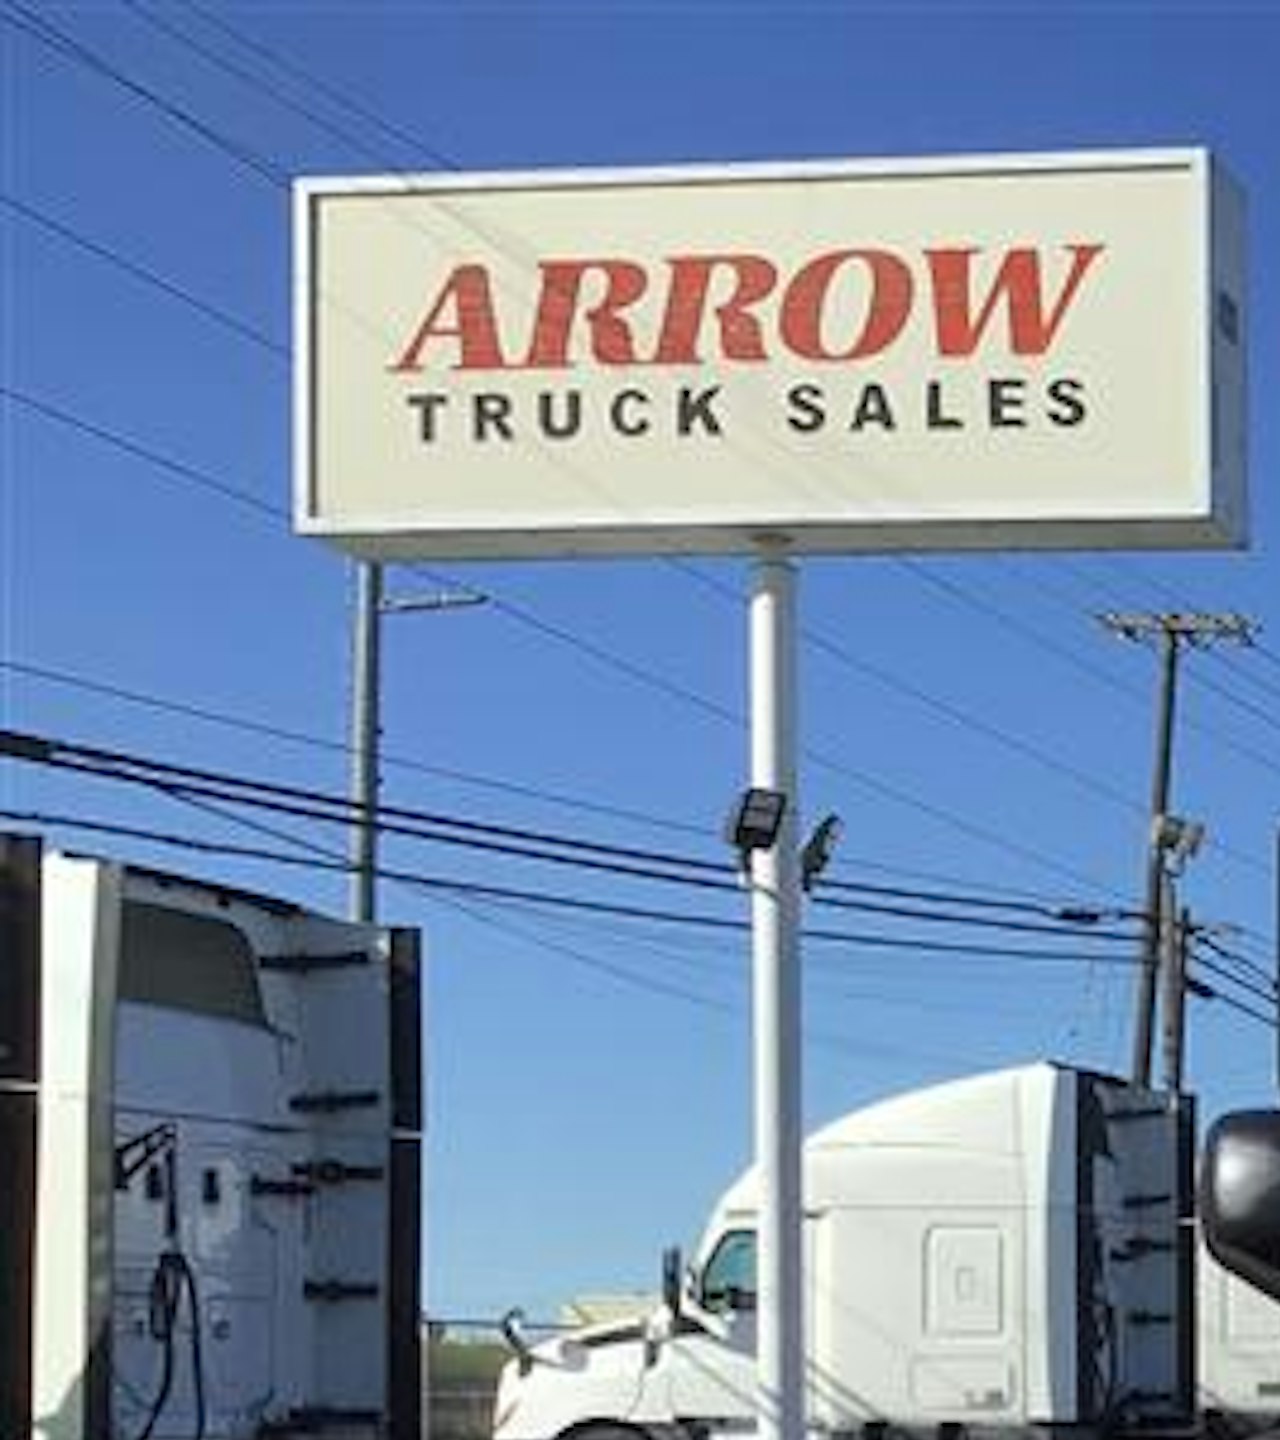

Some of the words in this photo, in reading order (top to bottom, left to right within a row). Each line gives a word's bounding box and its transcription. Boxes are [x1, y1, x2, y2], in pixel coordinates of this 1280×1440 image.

[390, 243, 1103, 374] ARROW
[406, 385, 723, 442] TRUCK
[786, 377, 1087, 434] SALES
